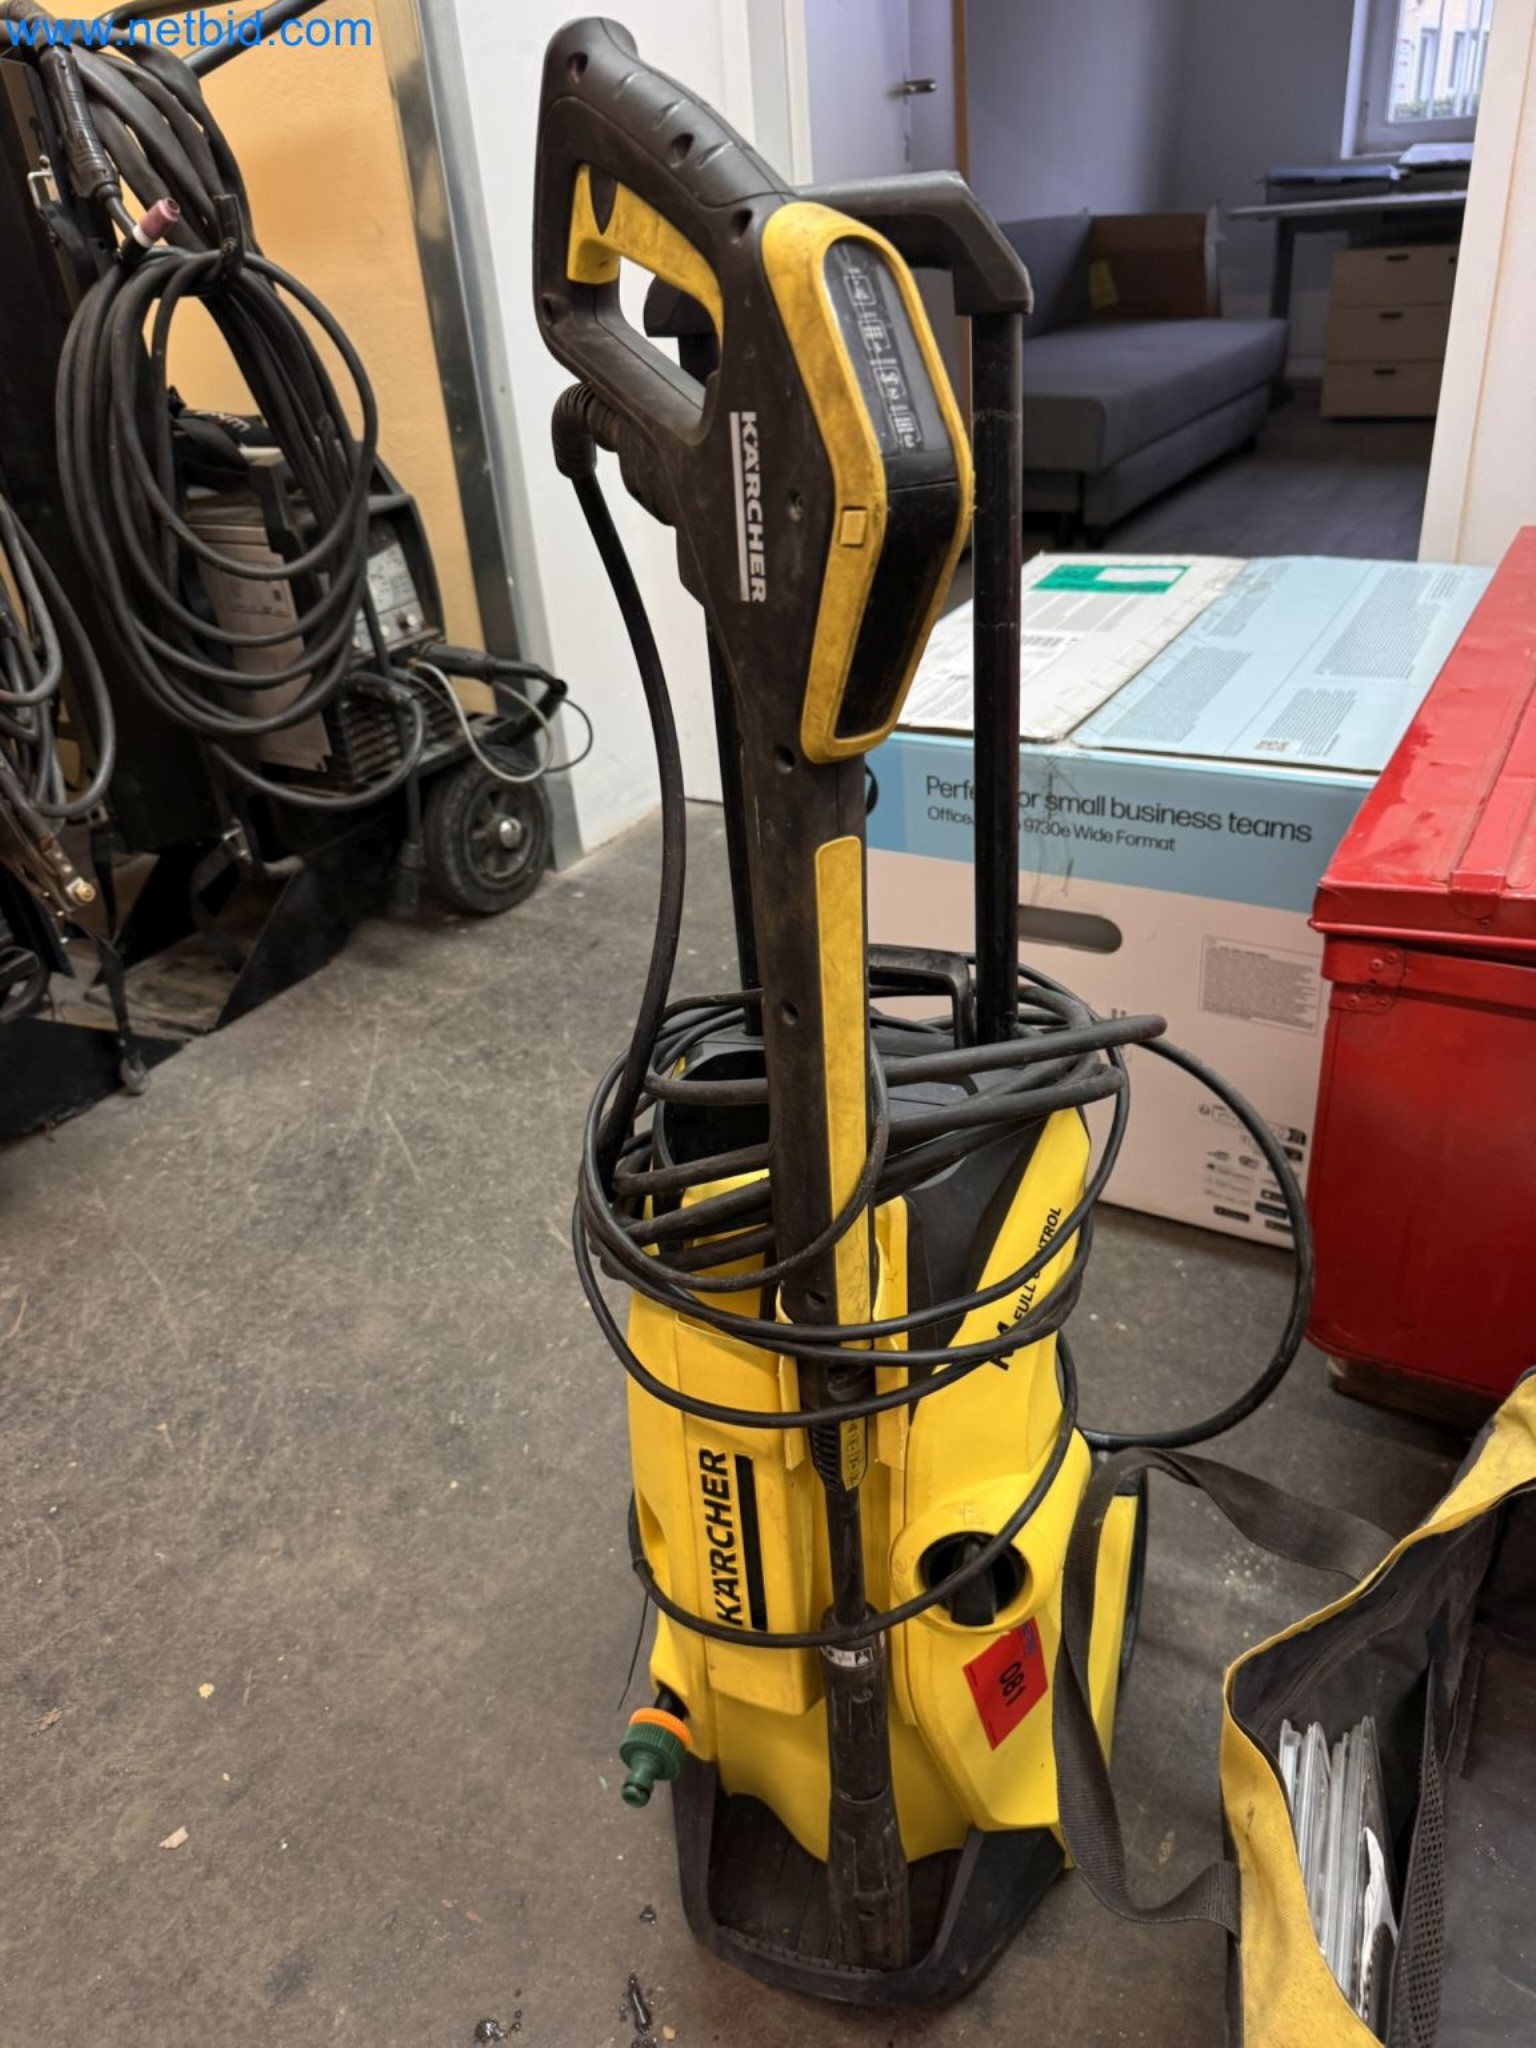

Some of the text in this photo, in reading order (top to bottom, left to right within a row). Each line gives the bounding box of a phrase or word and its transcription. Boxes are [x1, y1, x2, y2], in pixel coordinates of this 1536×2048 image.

[741, 411, 767, 603] KÄRCHER
[927, 805, 976, 826] Office
[1024, 819, 1071, 839] 9730e
[1073, 823, 1113, 844] Wide
[1115, 830, 1177, 853] Format
[1018, 790, 1041, 809] or
[1045, 793, 1106, 817] small
[1111, 797, 1222, 831] business
[1228, 811, 1313, 843] teams
[1033, 1207, 1062, 1278] TROL
[698, 1448, 744, 1626] KÄRCHER
[998, 1661, 1027, 1708] 081
